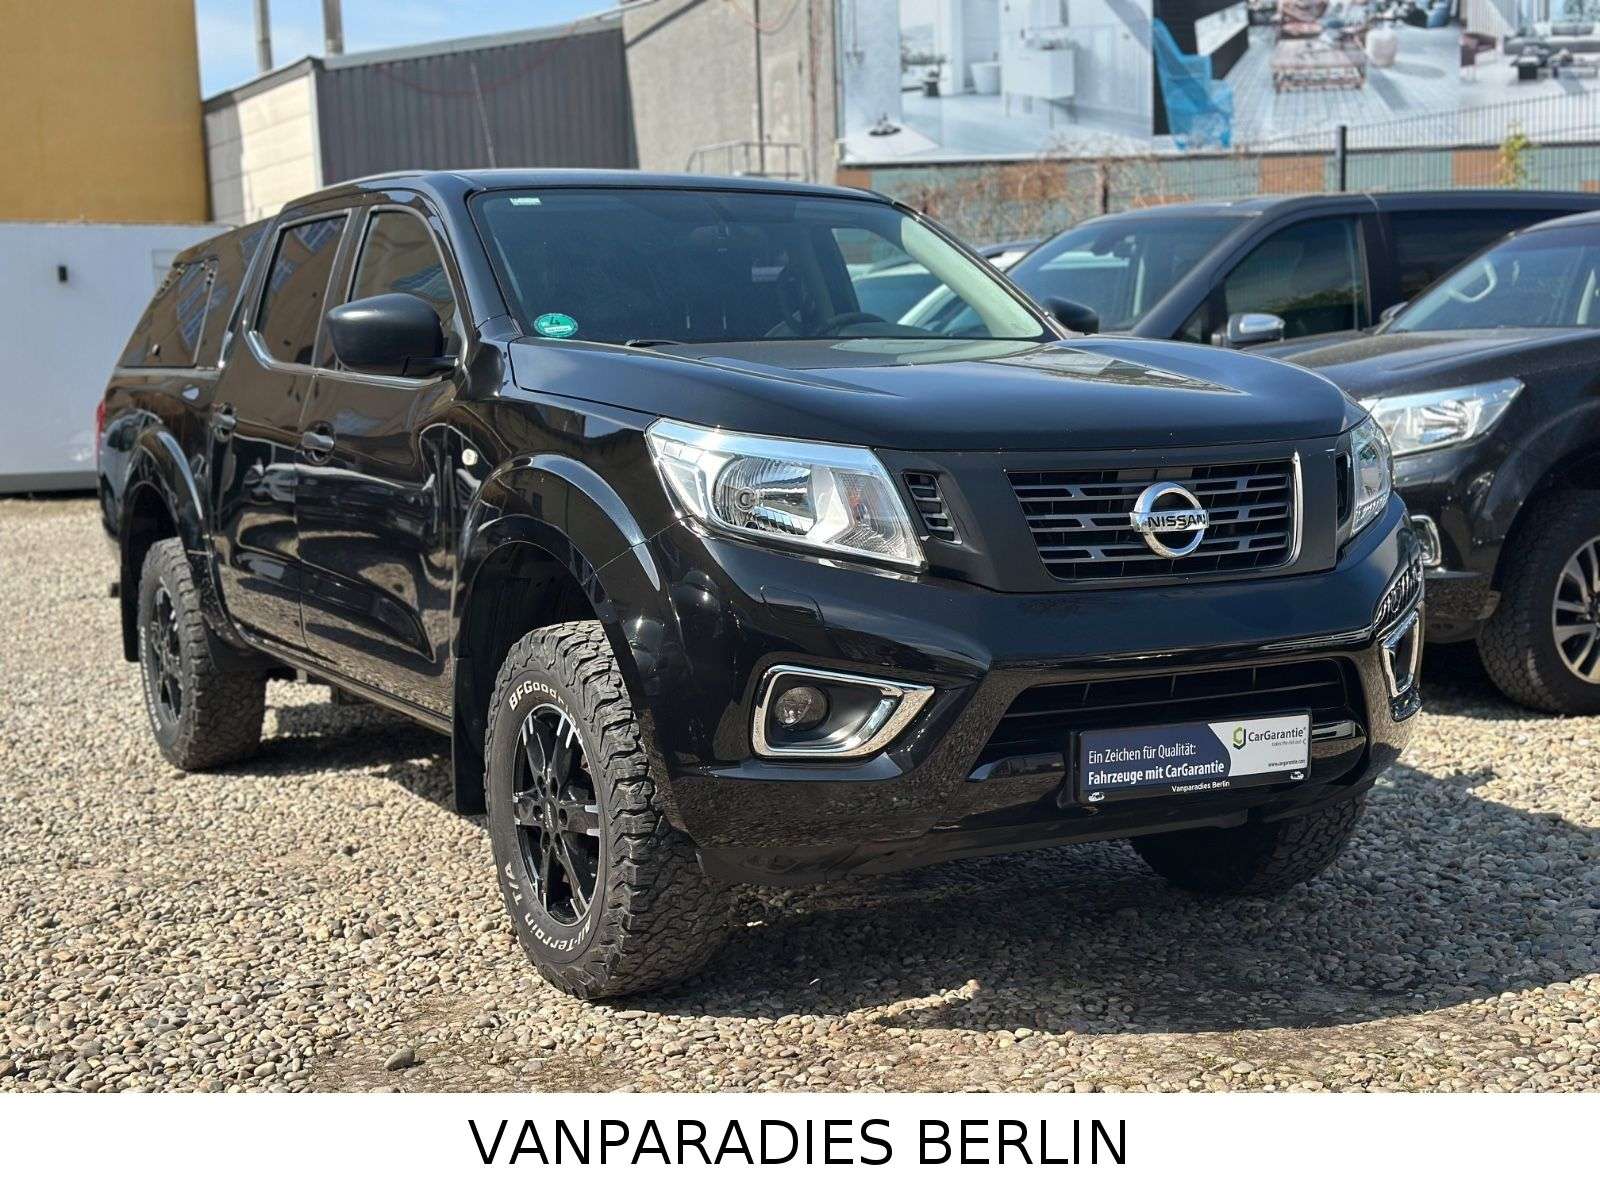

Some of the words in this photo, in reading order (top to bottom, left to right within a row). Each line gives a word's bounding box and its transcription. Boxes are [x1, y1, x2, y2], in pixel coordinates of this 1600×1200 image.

[1147, 514, 1206, 530] NISSAN
[1248, 727, 1304, 742] CarGarantie
[1088, 750, 1103, 764] Ein
[1105, 747, 1141, 763] Zeichen
[1143, 745, 1157, 760] für
[1158, 742, 1197, 759] Qualität:
[1088, 770, 1143, 785] Fahrzeuge
[1145, 765, 1164, 780] mit
[1165, 759, 1225, 778] CarGarantie
[1171, 782, 1211, 793] Vanparadies
[1212, 780, 1230, 789] Berlin
[504, 862, 523, 906] T/A
